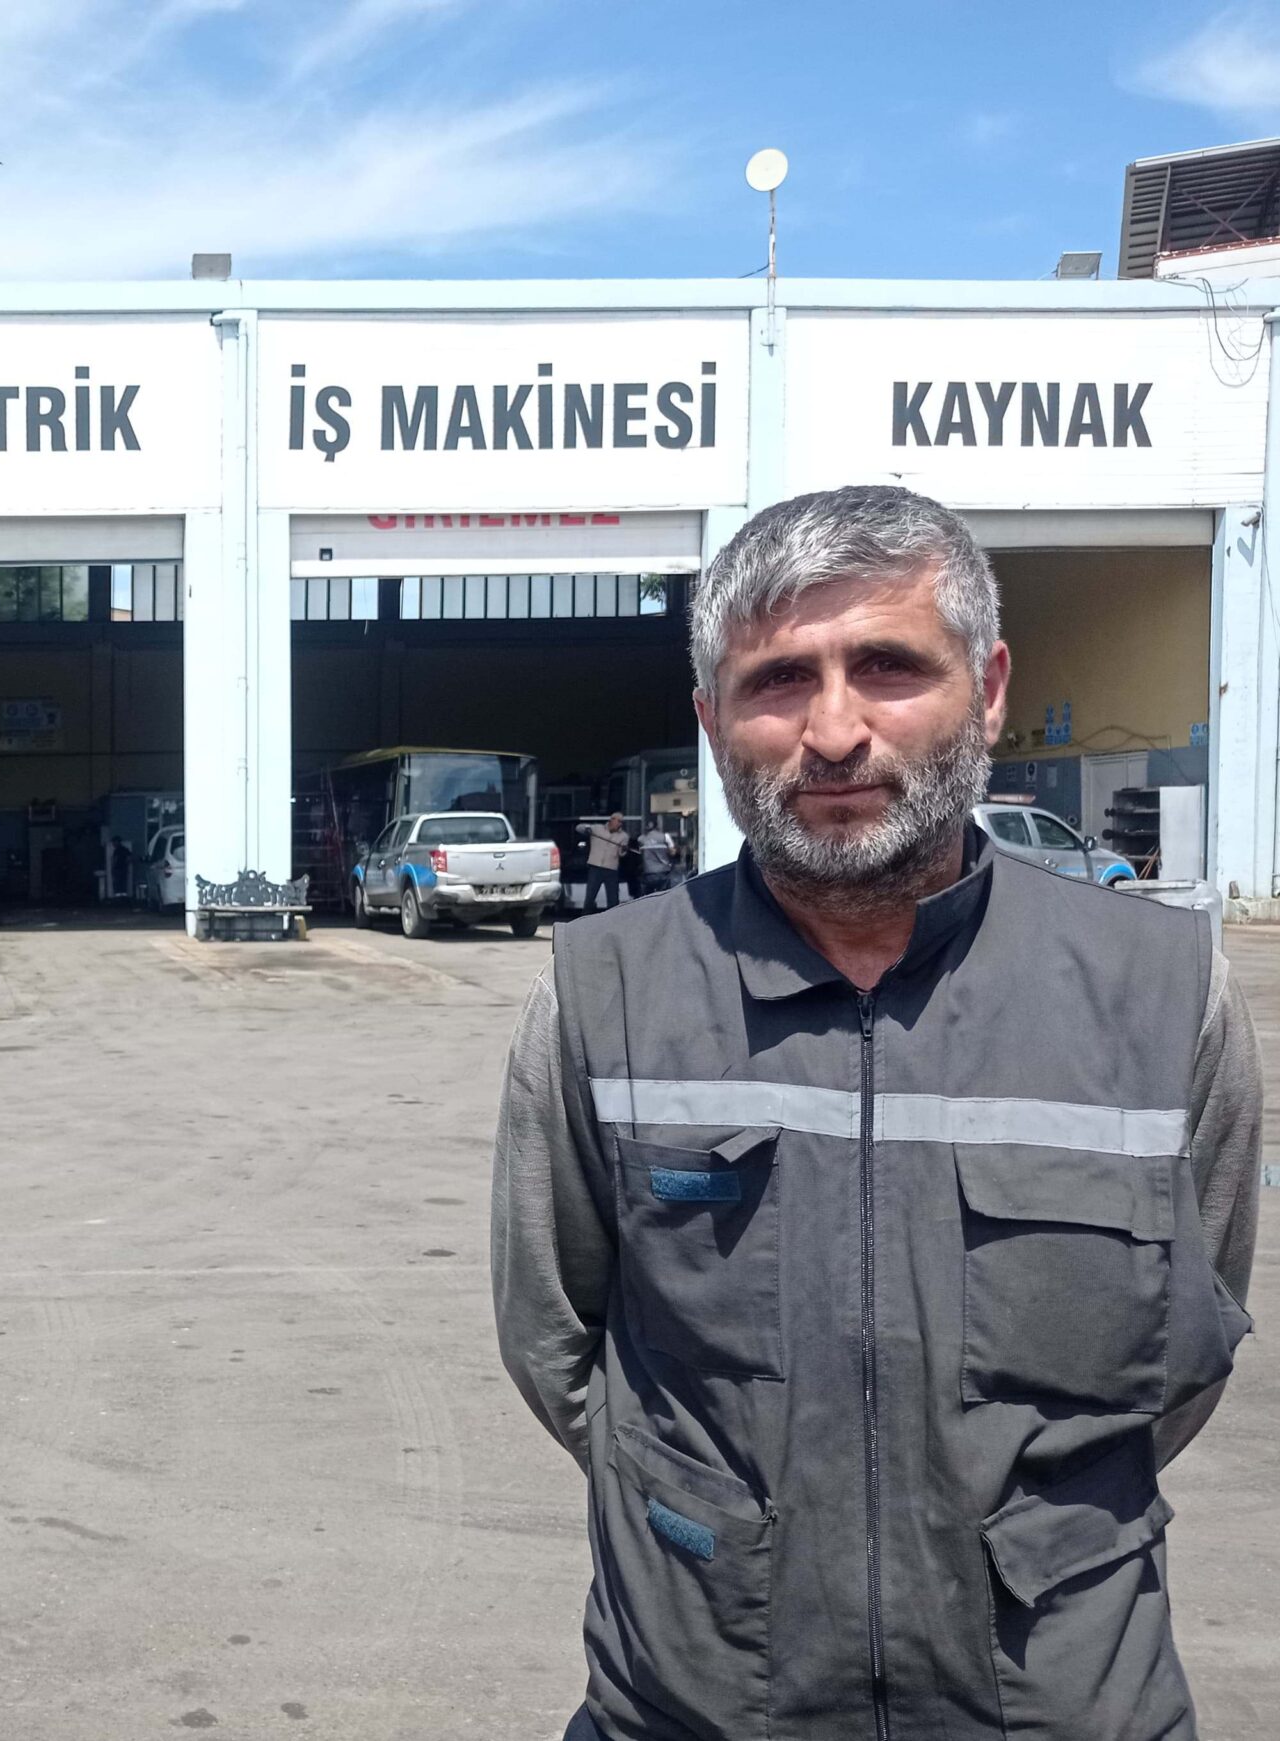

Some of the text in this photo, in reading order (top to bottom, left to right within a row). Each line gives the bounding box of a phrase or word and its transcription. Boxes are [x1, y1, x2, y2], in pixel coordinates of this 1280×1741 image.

[289, 361, 717, 462] İŞ MAKİNESİ
[892, 381, 1154, 448] KAYNAK
